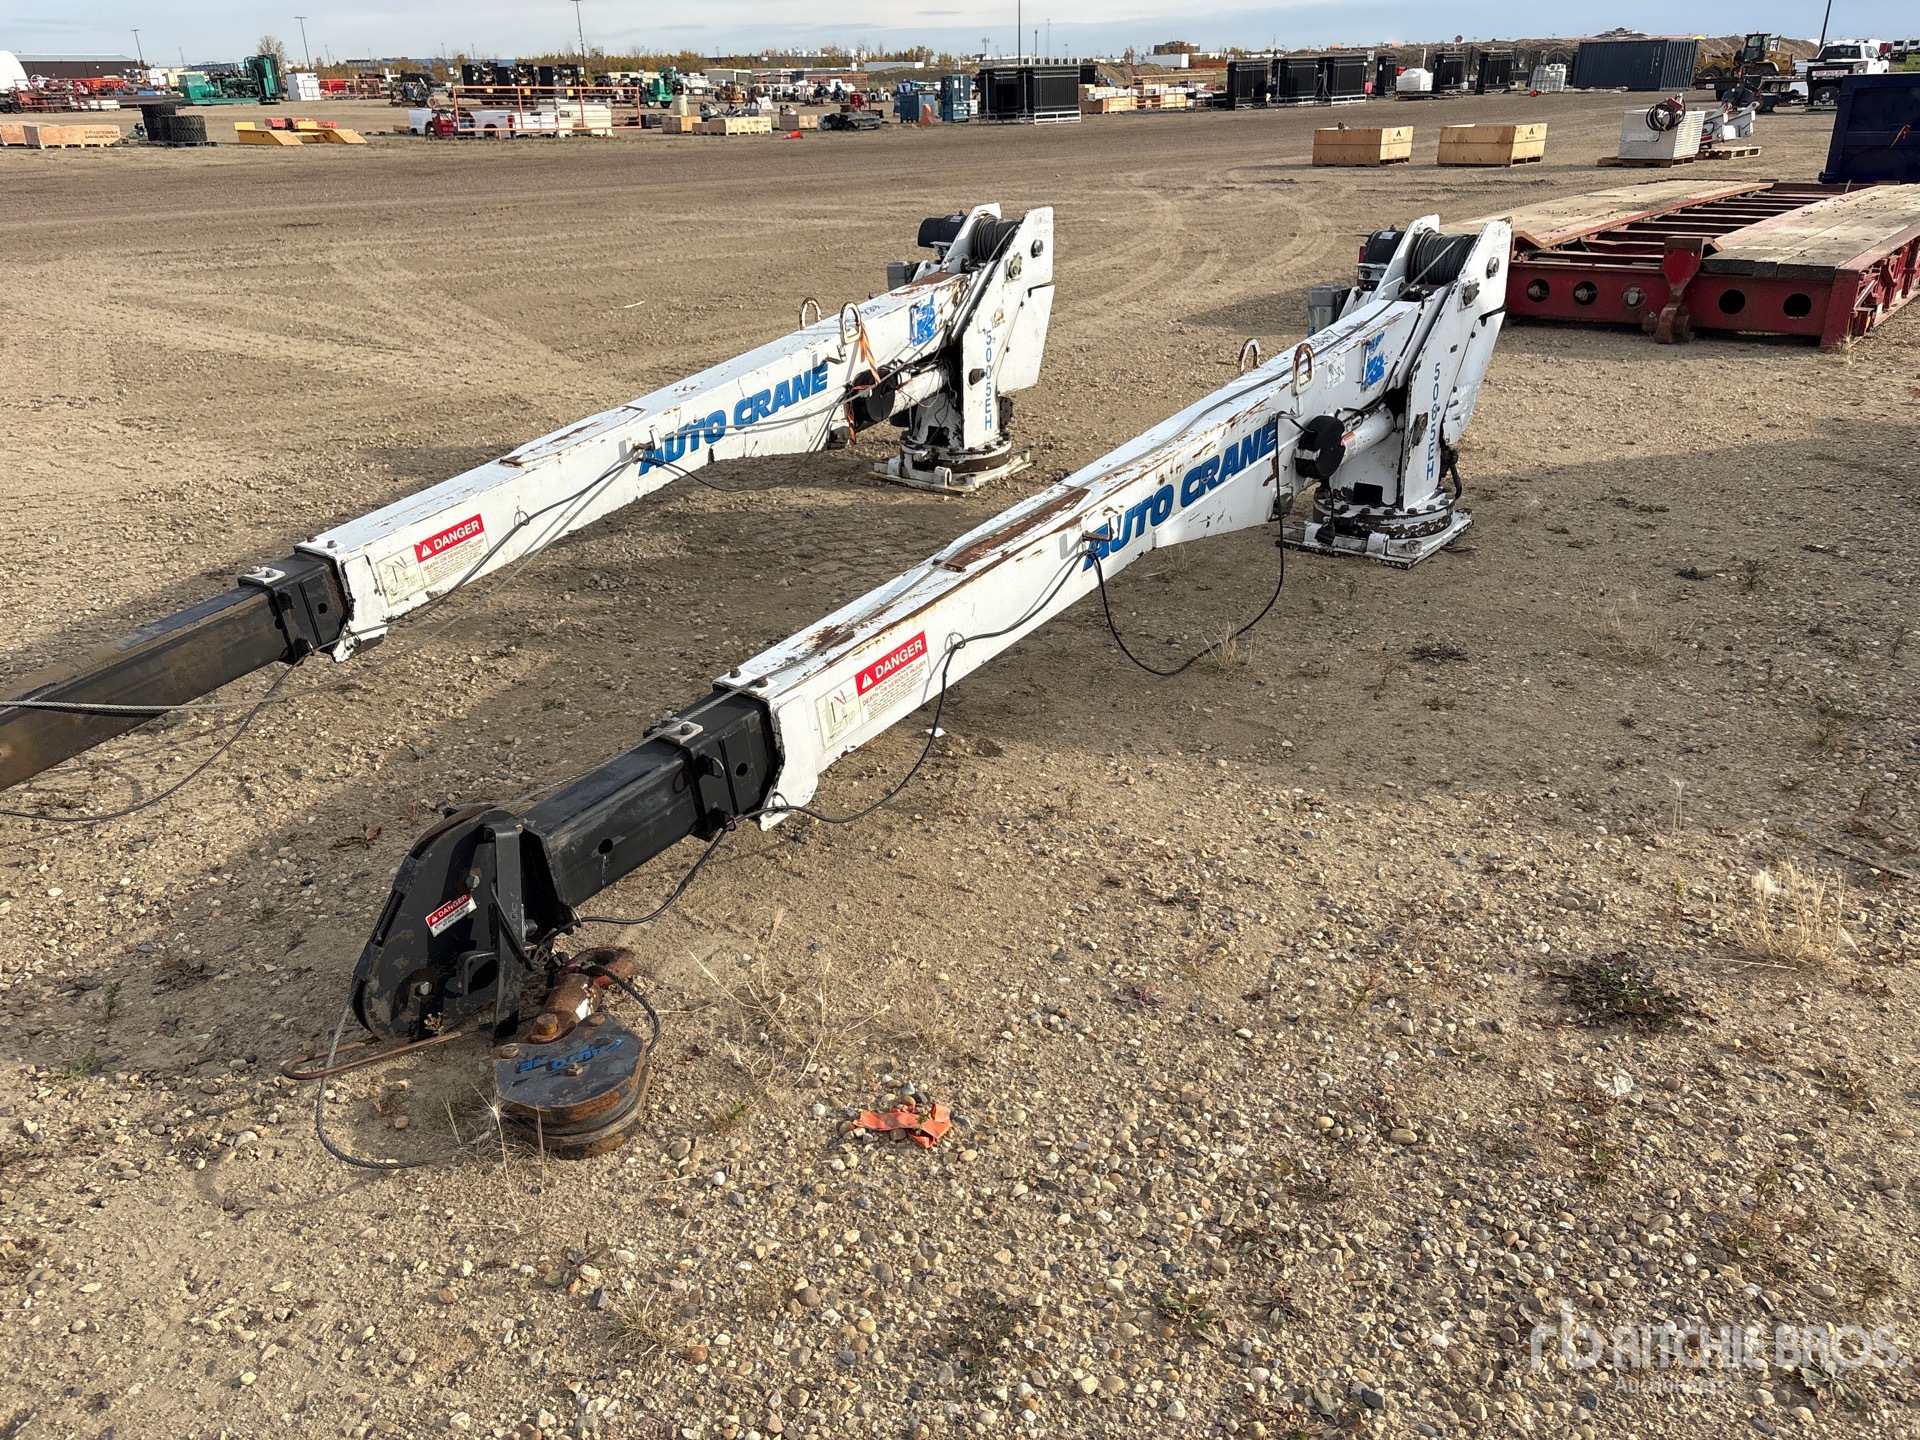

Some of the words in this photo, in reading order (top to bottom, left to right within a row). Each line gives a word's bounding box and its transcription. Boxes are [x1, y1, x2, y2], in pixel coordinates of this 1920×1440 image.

[638, 410, 727, 476] AUTO
[733, 363, 828, 430] CRANE
[985, 330, 993, 430] 5005EH
[1426, 362, 1441, 481] 5005EH
[433, 520, 480, 551] DANGER
[1082, 484, 1174, 572] AUTO
[1180, 421, 1278, 507] CRANE
[875, 639, 922, 679] DANGER
[438, 894, 467, 918] DANGER
